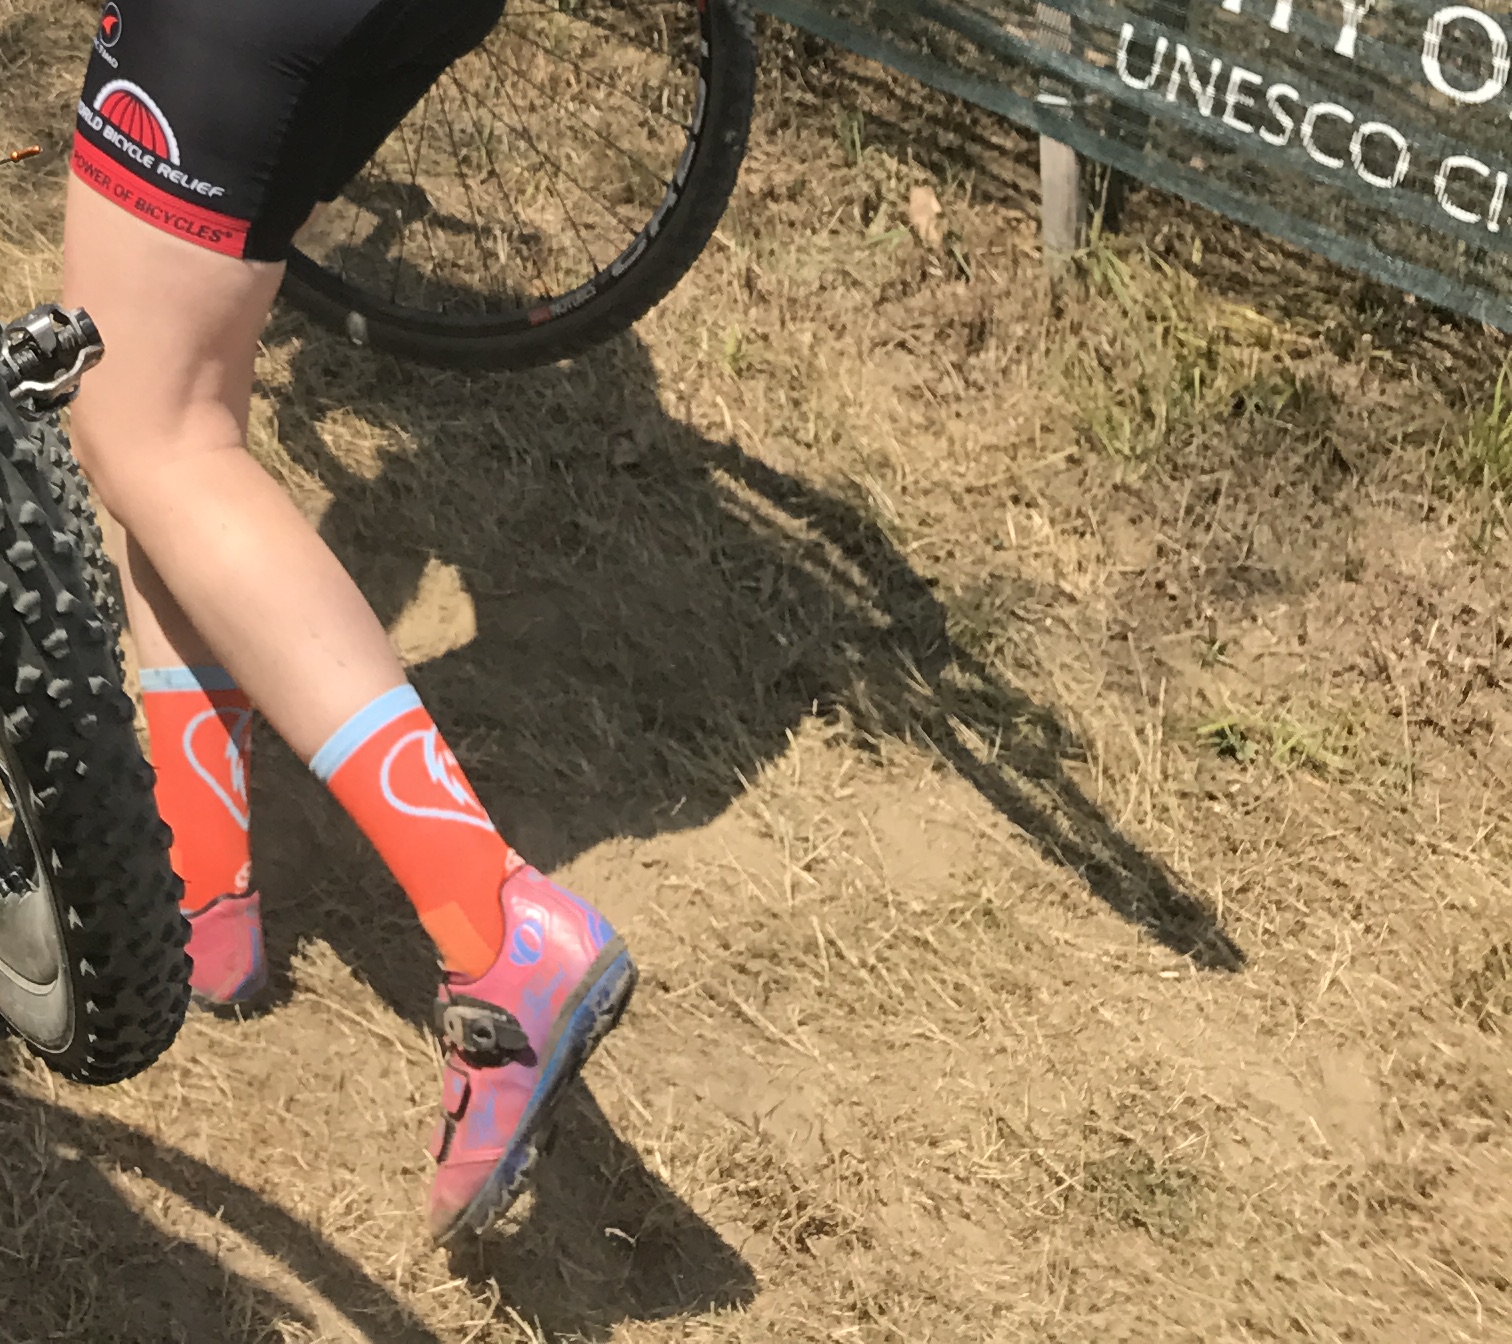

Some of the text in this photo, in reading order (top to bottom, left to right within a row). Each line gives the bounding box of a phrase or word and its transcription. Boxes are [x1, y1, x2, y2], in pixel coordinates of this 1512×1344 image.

[1421, 6, 1512, 104] O
[78, 99, 226, 198] ORLD BICYCLE RELIEF
[1115, 22, 1512, 233] UNESCO CI
[113, 182, 132, 202] OF
